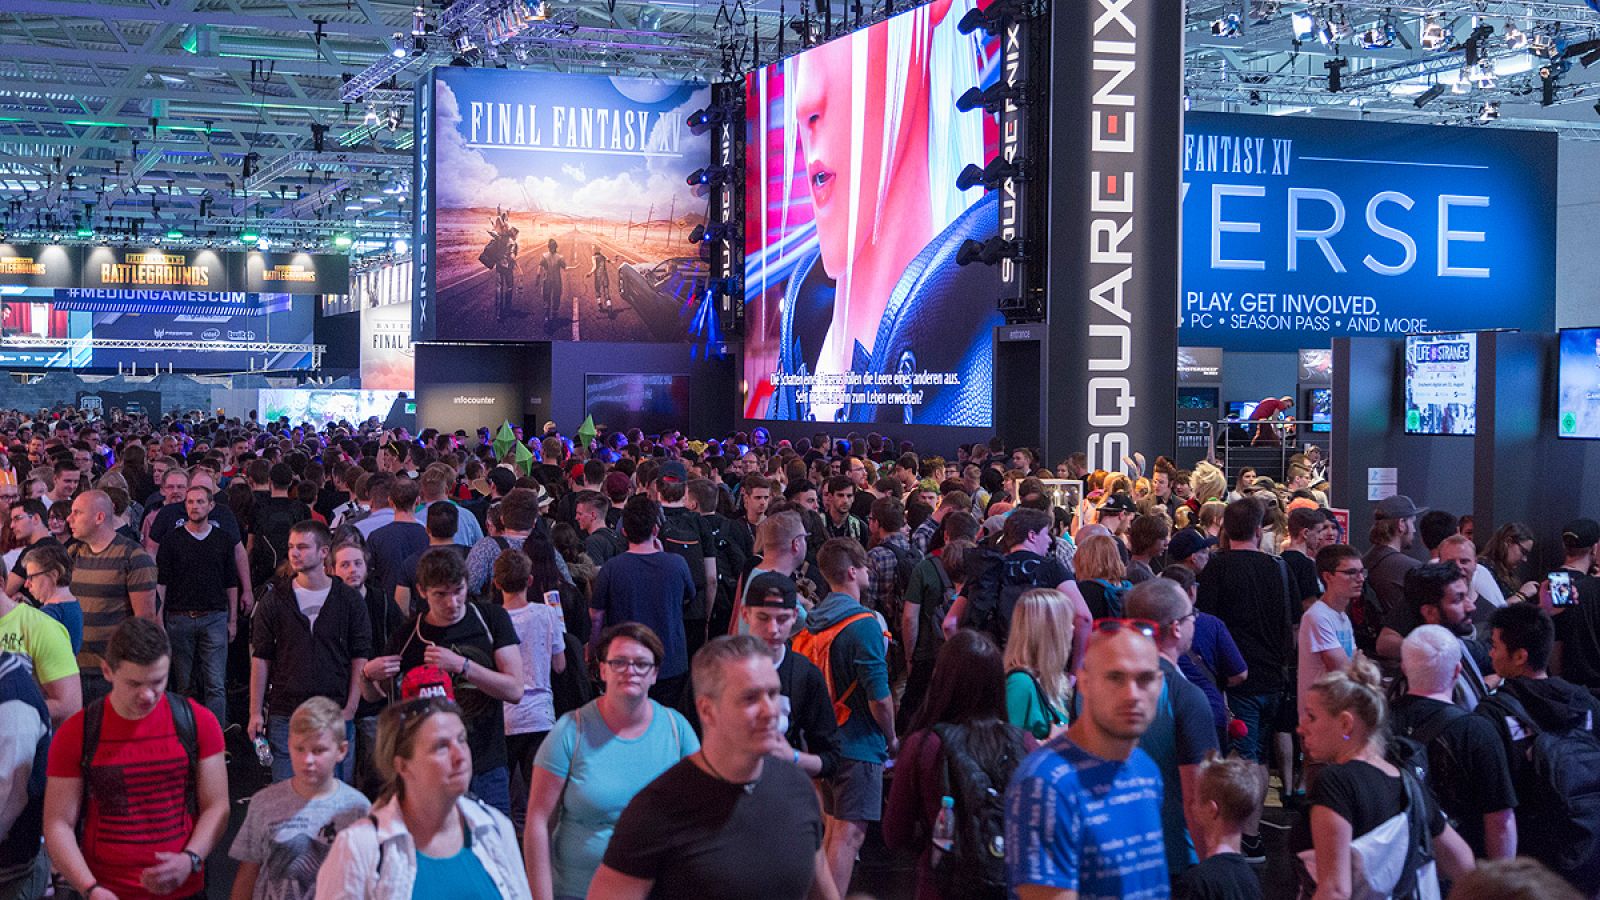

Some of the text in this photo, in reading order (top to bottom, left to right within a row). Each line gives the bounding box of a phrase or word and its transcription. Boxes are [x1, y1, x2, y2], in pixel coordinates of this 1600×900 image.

[470, 102, 682, 153] FINAL FANTASY XV
[1271, 138, 1293, 176] XV
[1182, 182, 1490, 279] ERSE
[101, 263, 209, 286] BATTLEGROUNDS
[1187, 291, 1380, 315] PLAY. GET INVOLVED.
[1087, 171, 1136, 474] SQUARE
[1191, 313, 1213, 328] PC
[1230, 314, 1292, 330] SEASON
[1295, 315, 1330, 331] PASS
[1346, 317, 1381, 332] AND
[372, 334, 404, 348] FINAL
